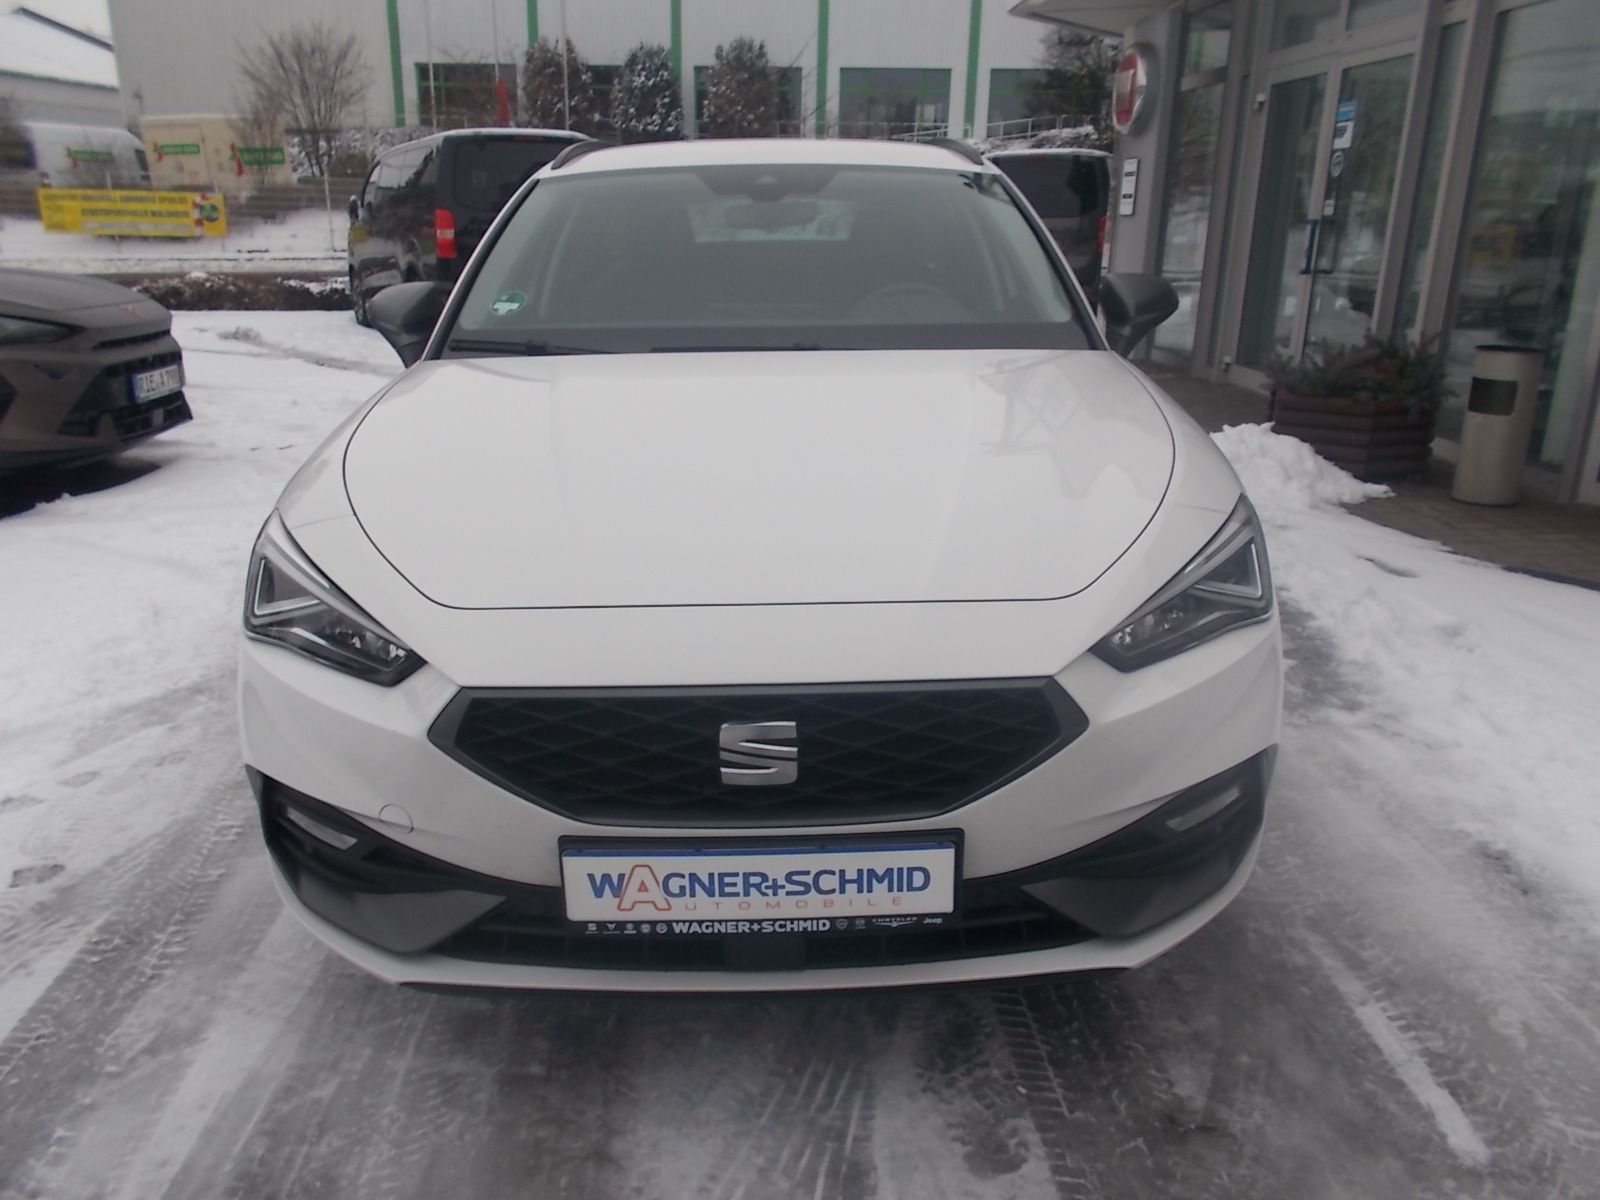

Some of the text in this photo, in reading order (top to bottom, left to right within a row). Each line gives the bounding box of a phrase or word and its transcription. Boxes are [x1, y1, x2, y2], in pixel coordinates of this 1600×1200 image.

[586, 864, 931, 911] WAGNER+SCHMID
[671, 919, 831, 934] WAGNER+SCHMID
[922, 916, 943, 924] Jeep
